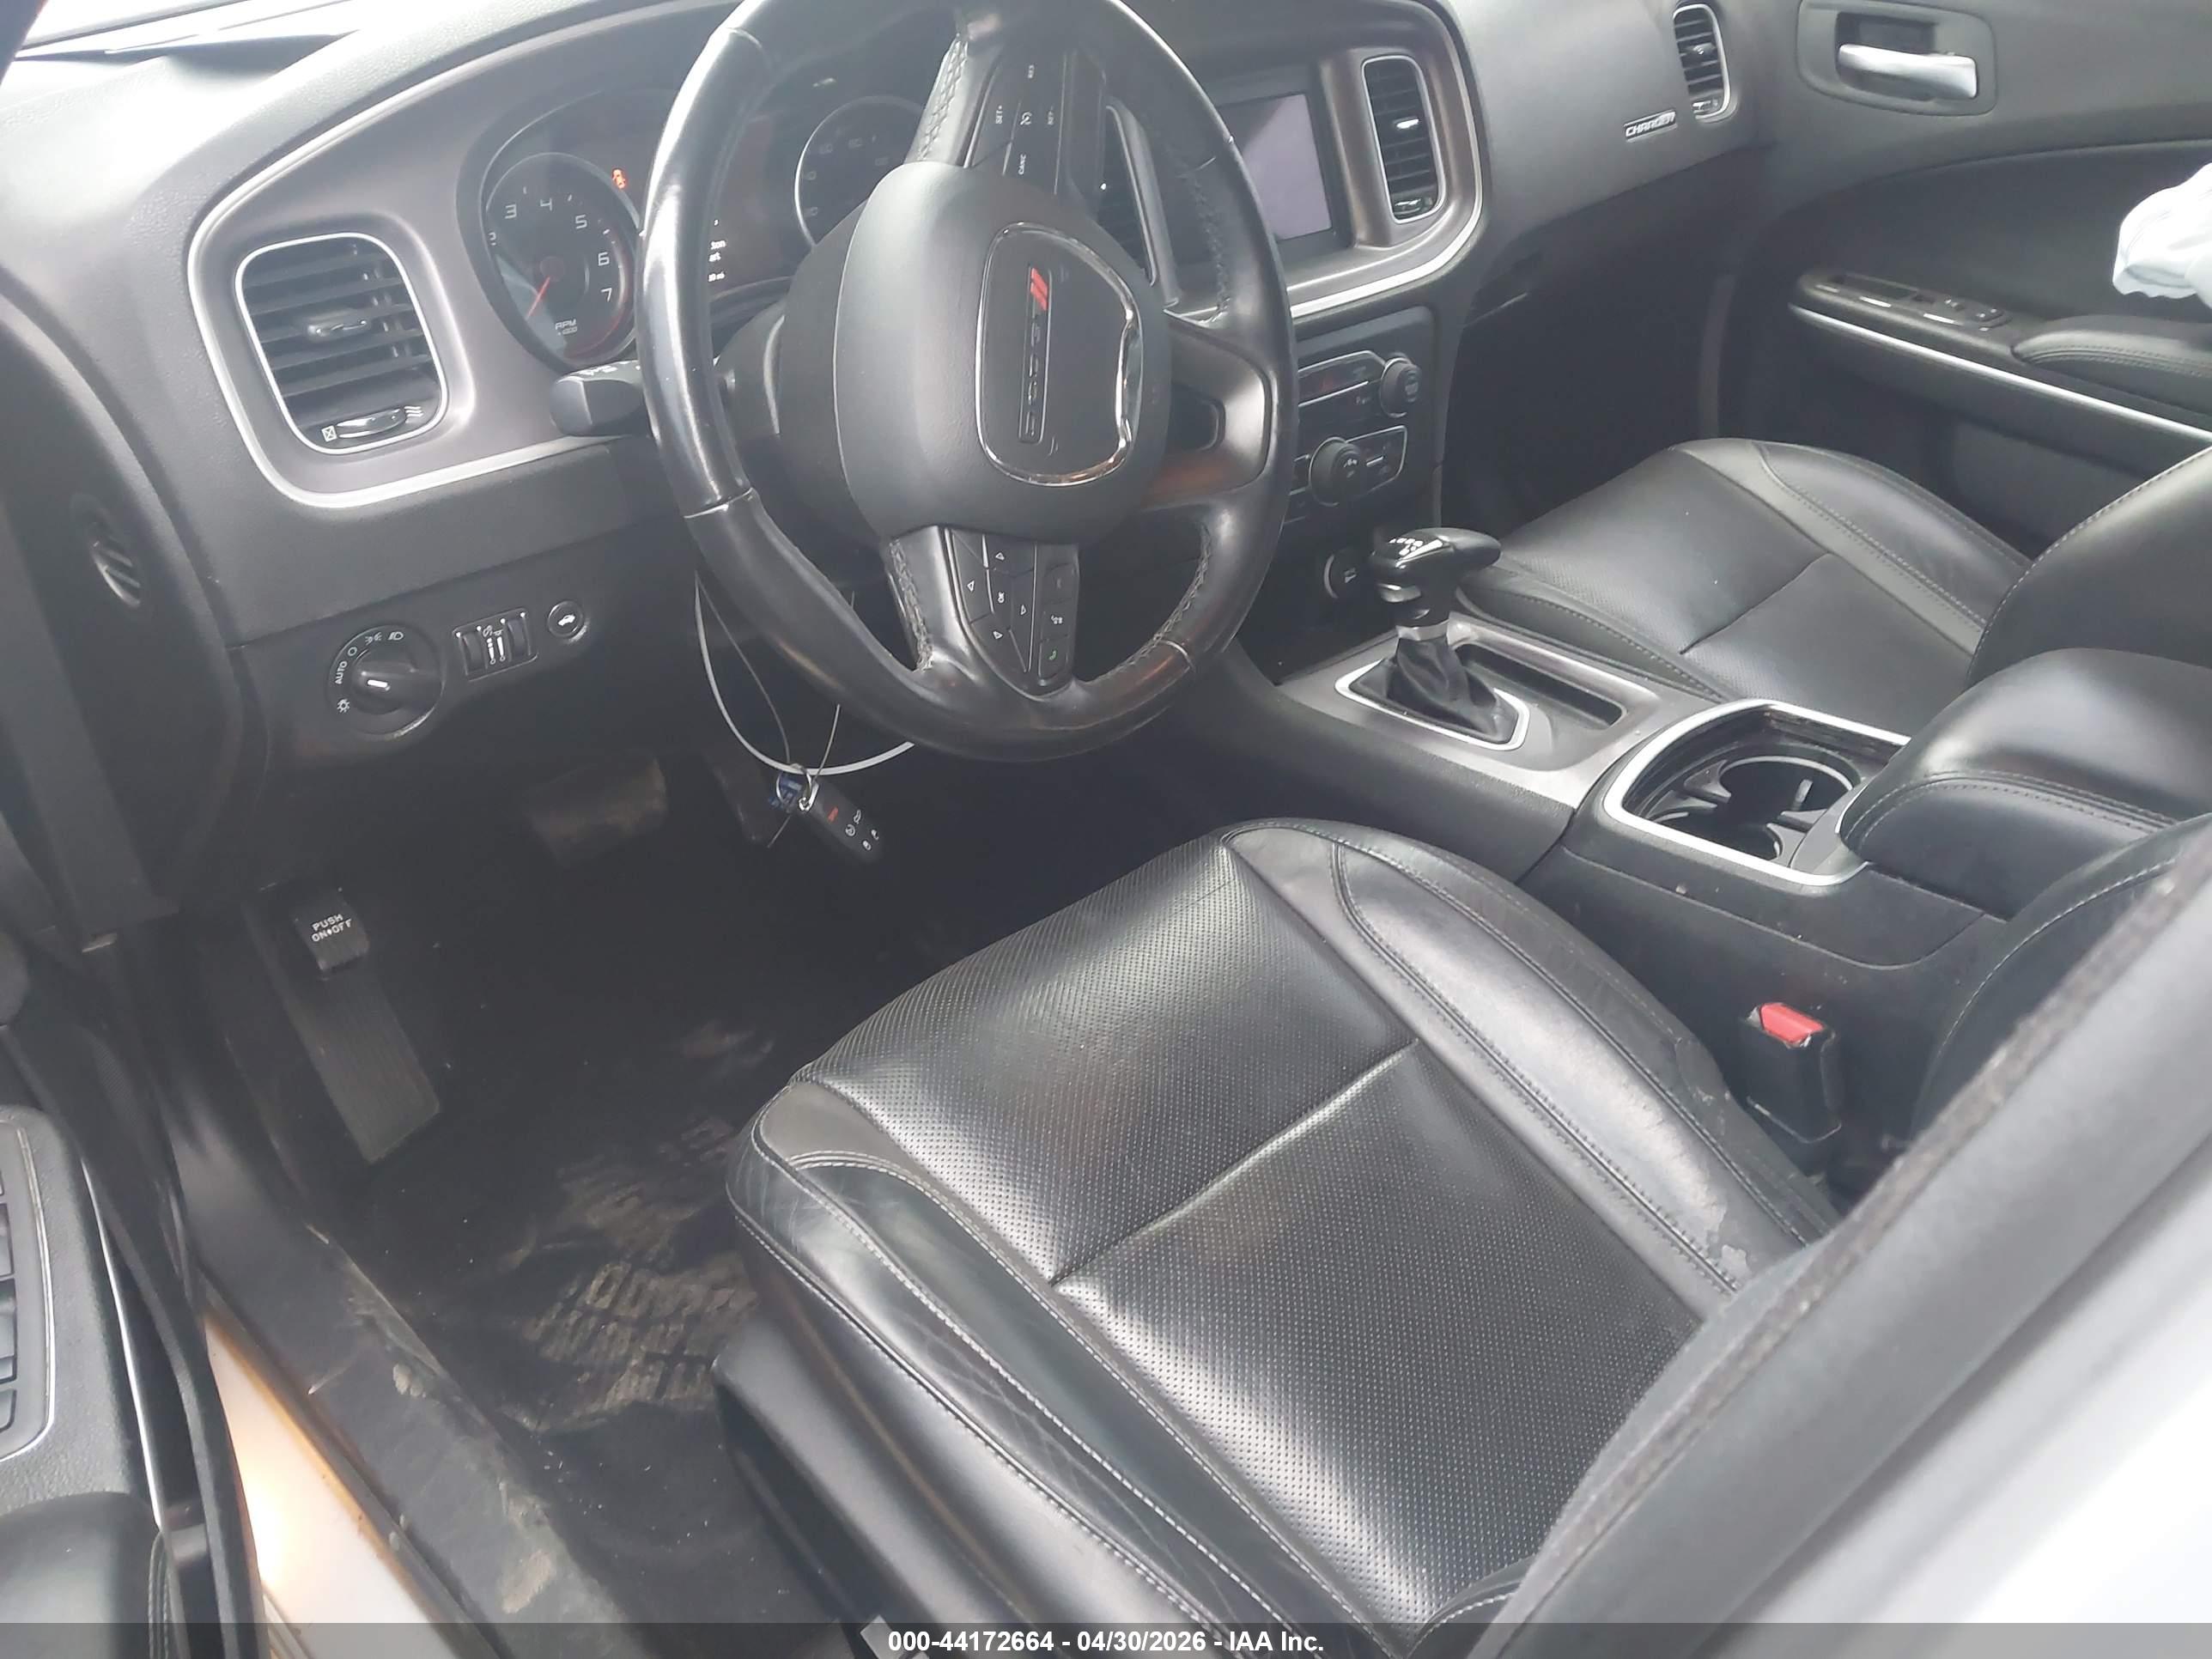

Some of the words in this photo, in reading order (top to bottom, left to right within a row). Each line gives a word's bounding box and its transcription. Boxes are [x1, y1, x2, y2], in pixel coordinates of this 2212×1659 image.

[505, 204, 517, 219] 3
[540, 198, 552, 211] 4
[575, 215, 588, 229] 5
[598, 252, 610, 266] 6
[601, 288, 612, 302] 7
[334, 660, 348, 684] AUTO
[312, 914, 343, 932] PUSH
